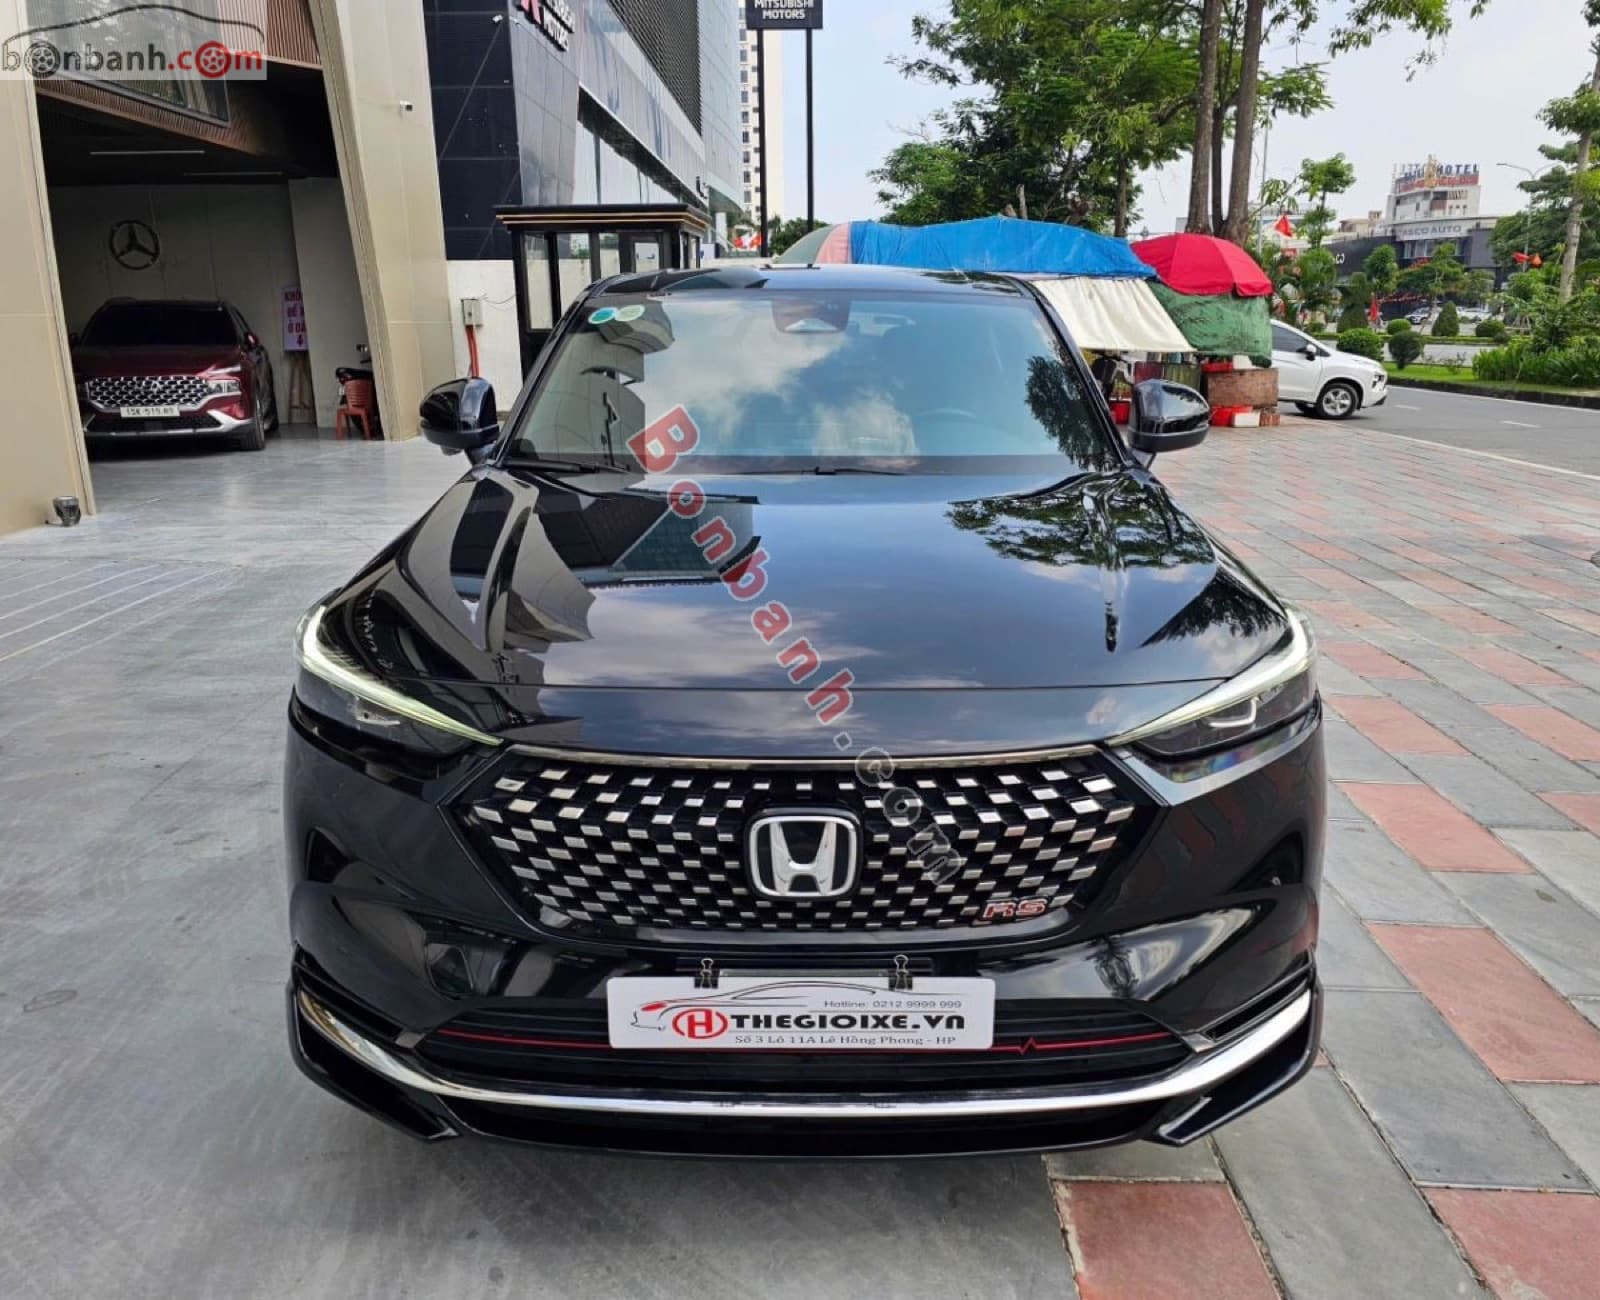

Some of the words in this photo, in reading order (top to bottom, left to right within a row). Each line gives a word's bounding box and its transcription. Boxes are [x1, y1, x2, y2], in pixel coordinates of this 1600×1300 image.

[762, 9, 806, 20] MOTORS
[1431, 224, 1461, 235] AUTO
[983, 898, 1047, 918] RS
[872, 1000, 901, 1009] 0212
[939, 1000, 963, 1009] 999
[755, 1036, 764, 1044] 3
[767, 1035, 785, 1044] Lô
[790, 1036, 817, 1044] 11A
[820, 1034, 836, 1044] Lê
[880, 1035, 924, 1046] Phong
[936, 1036, 957, 1045] HP
